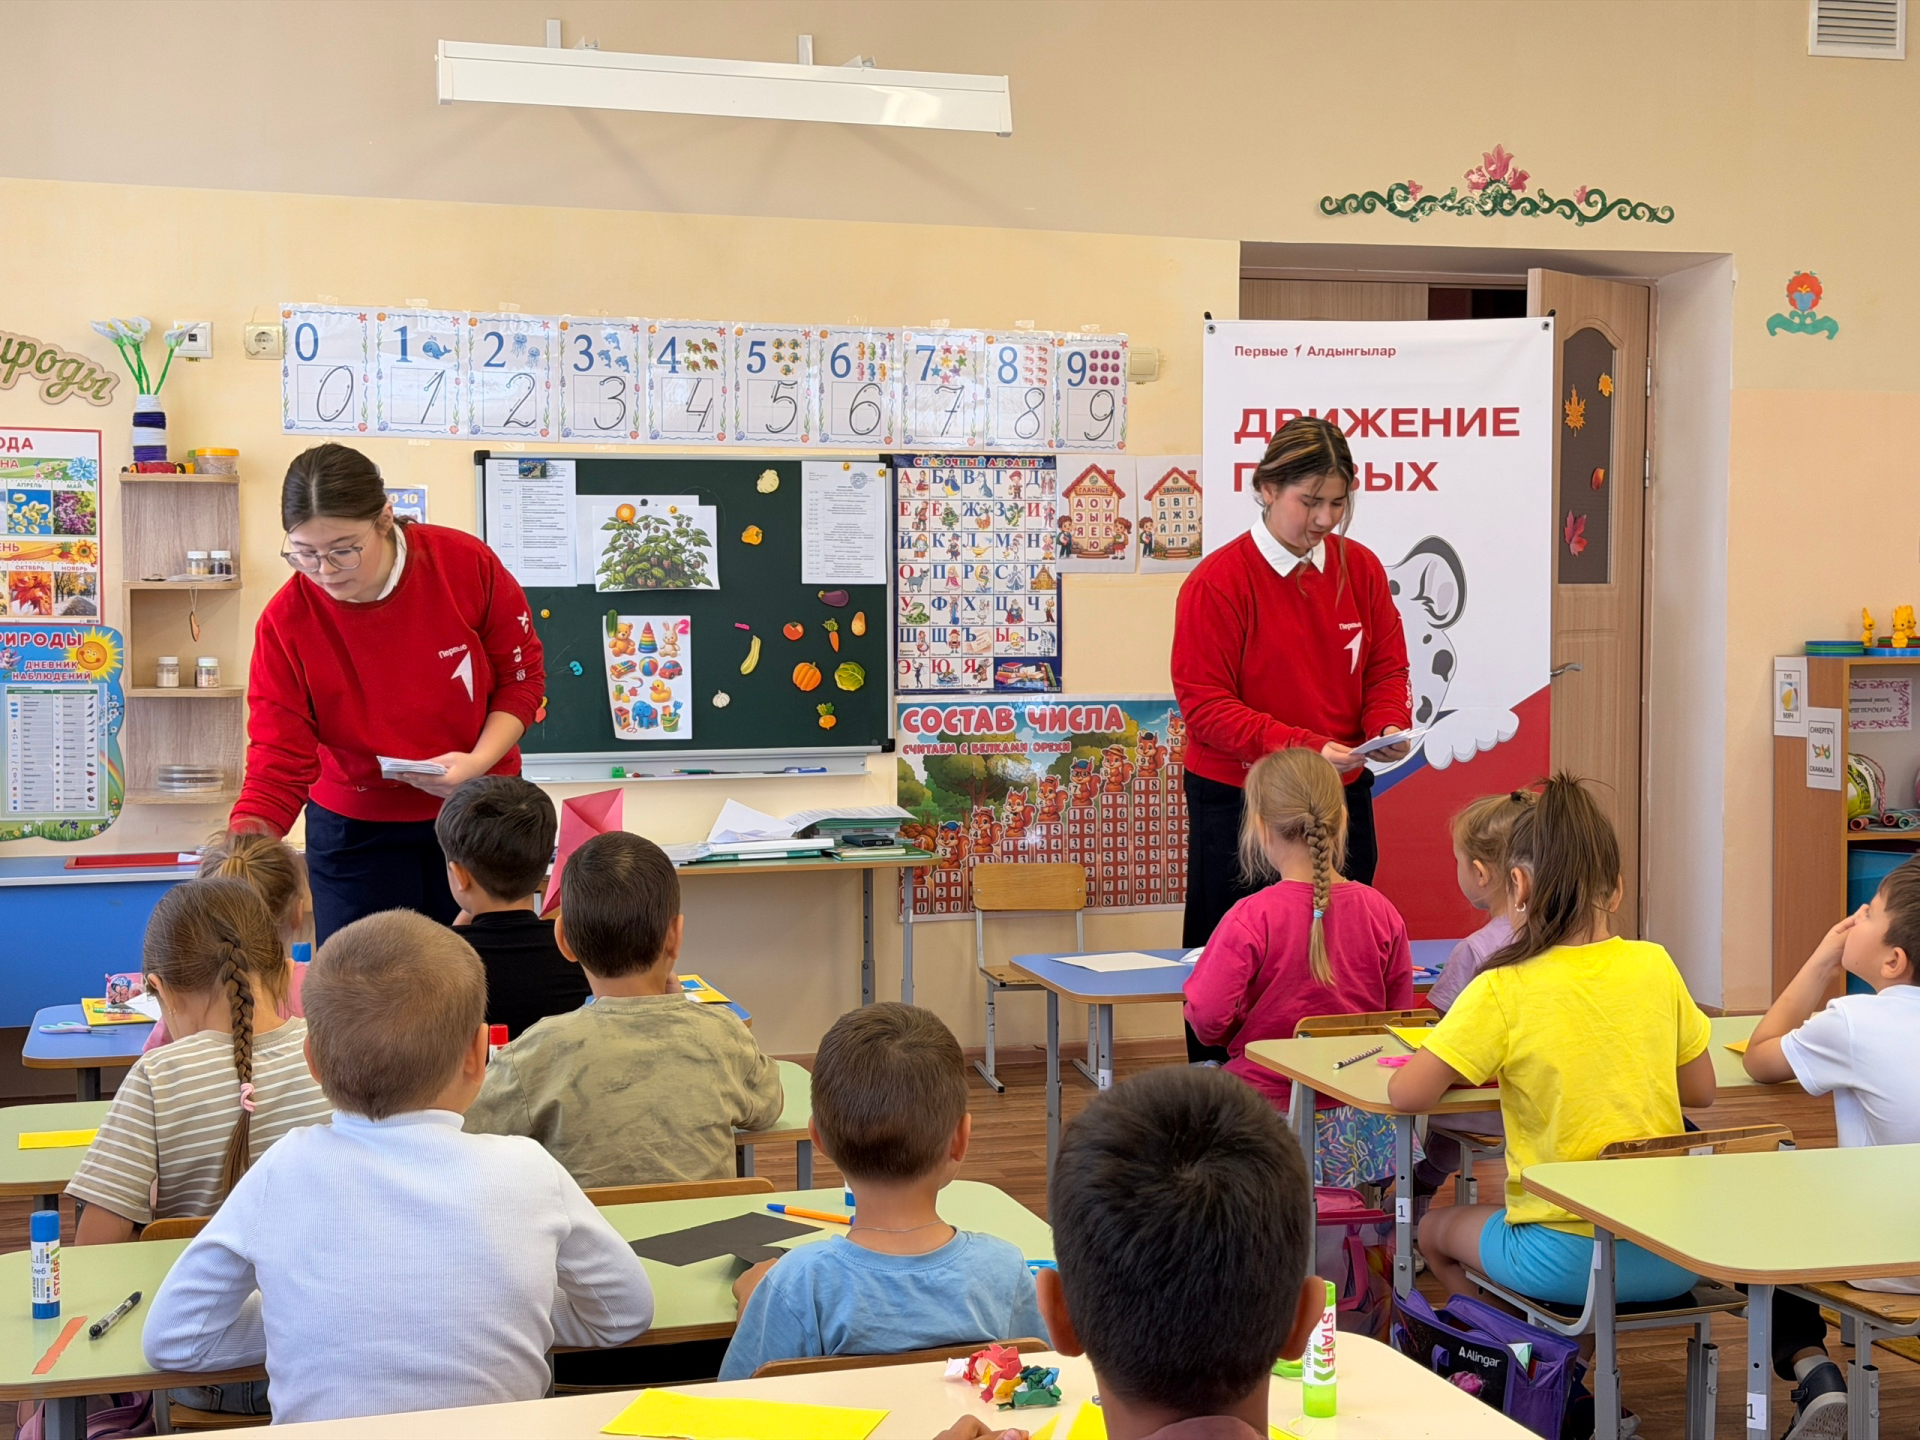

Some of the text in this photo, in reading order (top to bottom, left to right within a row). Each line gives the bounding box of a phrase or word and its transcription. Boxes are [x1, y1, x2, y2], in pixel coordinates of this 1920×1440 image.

[295, 323, 1087, 387] 0 1 2 3 4 5 6 7 8 9
[1235, 346, 1396, 358] Первые Алдынгылар
[316, 364, 1115, 440] 0 1 2 3 4 5 6 7 8 9
[914, 456, 1043, 468] СКАЗОЧНЫЙ АЛФАВИТ
[900, 470, 1041, 486] А Б В Г Д
[1234, 462, 1439, 492] ПЫХ
[67, 481, 82, 489] МАЙ
[402, 493, 418, 504] 10
[1076, 499, 1112, 508] А О У
[1159, 498, 1194, 507] Б В Г
[900, 500, 1041, 517] Е Ё Ж З И
[1076, 513, 1112, 522] Э Ы И
[1159, 511, 1194, 520] Д Ж З
[1077, 526, 1111, 536] Я Е Ё
[1160, 524, 1166, 533] Й
[1174, 524, 1180, 532] Л
[900, 531, 1041, 549] Й К Л М Н
[1090, 541, 1099, 549] Ю
[1168, 538, 1174, 546] Н
[900, 565, 1039, 580] О П Р С Т
[900, 596, 1040, 614] У Ф Х Ц Ч
[678, 619, 690, 634] 2
[0, 633, 82, 648] ИРОДЫ
[900, 627, 1039, 645] Ш Щ Ъ Ы Ь
[26, 661, 78, 670] ДНЕВНИК
[899, 658, 976, 674] Э Ю Я
[12, 671, 91, 682] НАБЛЮДЕНИЙ
[903, 706, 1124, 733] СОСТАВ ЧИСЛА
[903, 742, 1071, 754] СЧИТАЕМ С БЕЛКАМИ ОРЕХИ
[1138, 781, 1157, 790] 1 8
[1105, 796, 1125, 804] 1 7
[1137, 795, 1157, 804] 2 7
[1105, 809, 1125, 818] 2 6
[1138, 808, 1158, 817] 3 6
[1105, 823, 1125, 833] 3 5
[1138, 821, 1158, 831] 4 5
[1138, 836, 1158, 846] 5 4
[1138, 850, 1158, 860] 6 3
[1138, 865, 1158, 874] 7 2
[1138, 880, 1157, 889] 8 1
[1138, 894, 1158, 904] 9 0
[1101, 1076, 1106, 1086] 1
[1398, 1205, 1405, 1217] 1
[1322, 1312, 1334, 1367] STAFF
[1466, 1350, 1501, 1367] Alingar
[1747, 1403, 1756, 1420] 1
